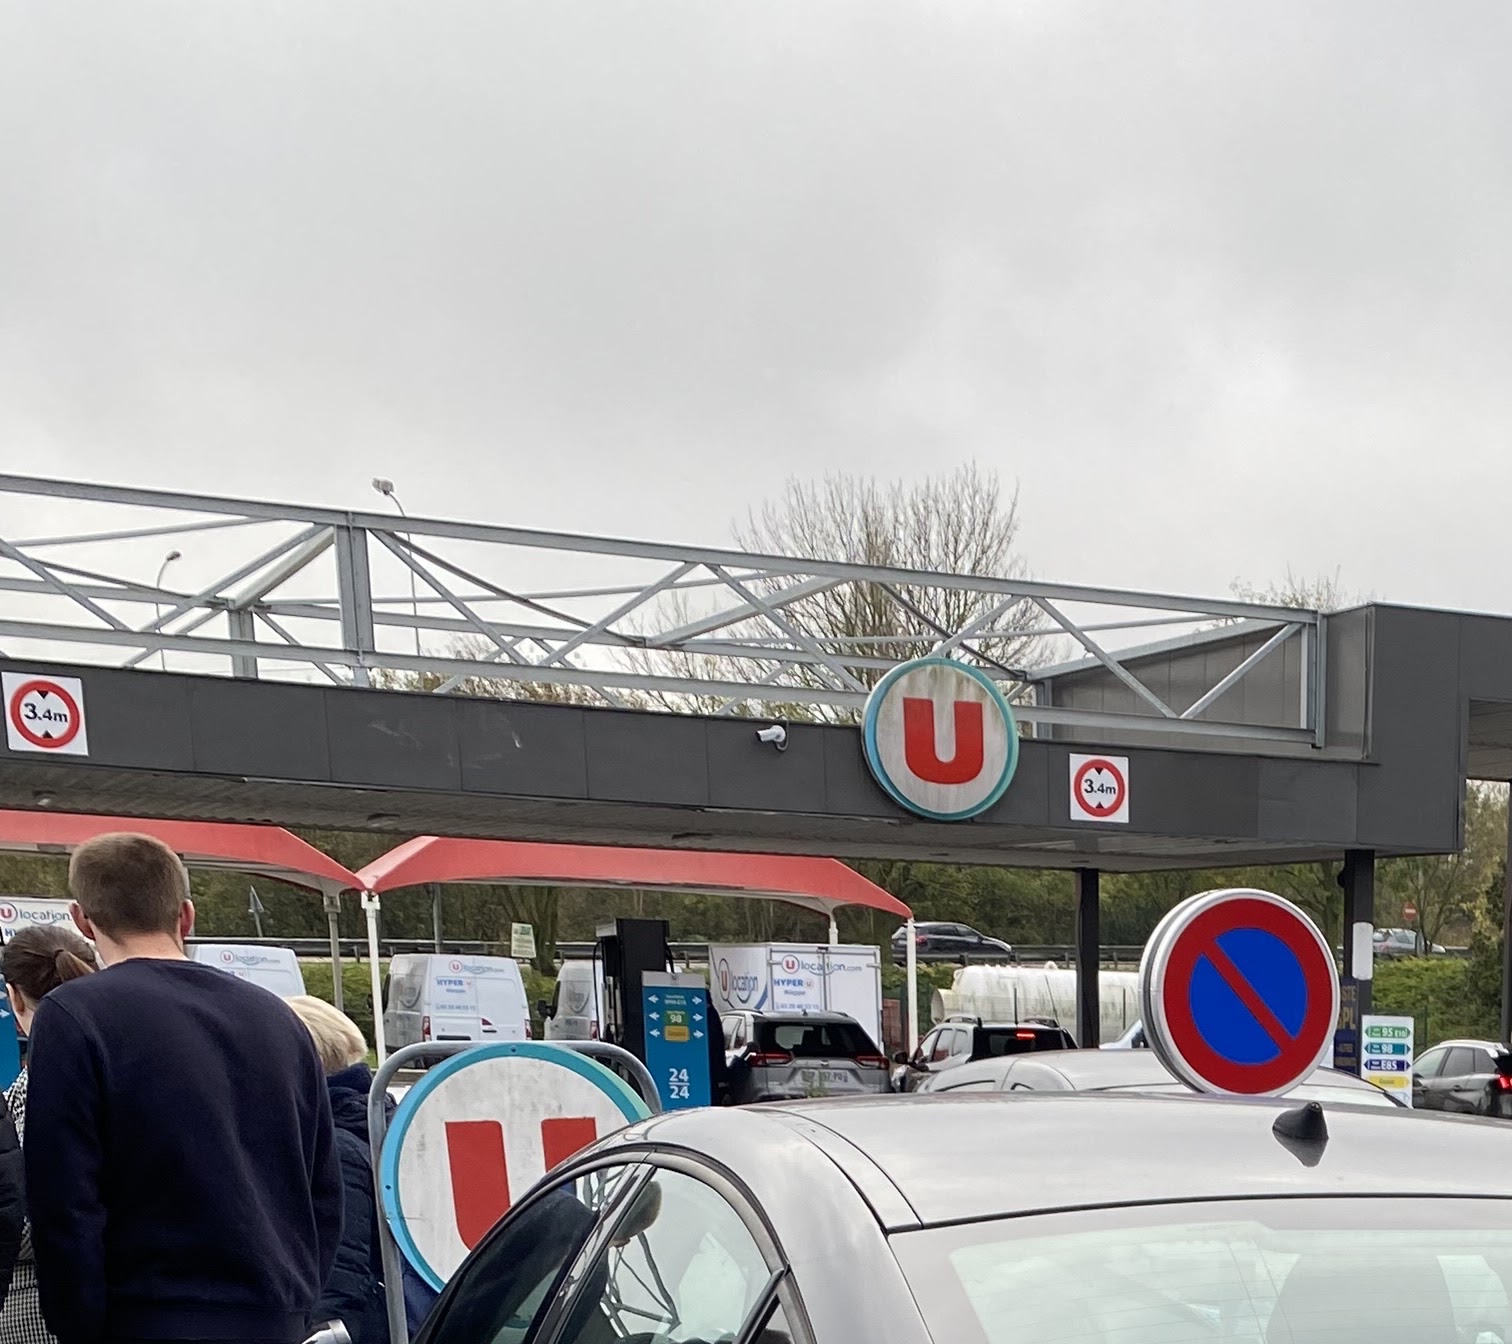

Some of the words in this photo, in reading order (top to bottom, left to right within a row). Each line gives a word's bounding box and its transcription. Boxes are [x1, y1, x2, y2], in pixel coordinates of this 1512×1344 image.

[24, 702, 68, 723] 3.4m
[903, 697, 984, 785] U
[1084, 778, 1116, 795] 3.4m
[20, 908, 71, 921] location
[786, 959, 795, 970] U
[773, 979, 804, 987] HYPER
[1381, 1027, 1393, 1037] 95
[1381, 1043, 1393, 1054] 98
[668, 1068, 689, 1082] 24
[669, 1085, 690, 1099] 24
